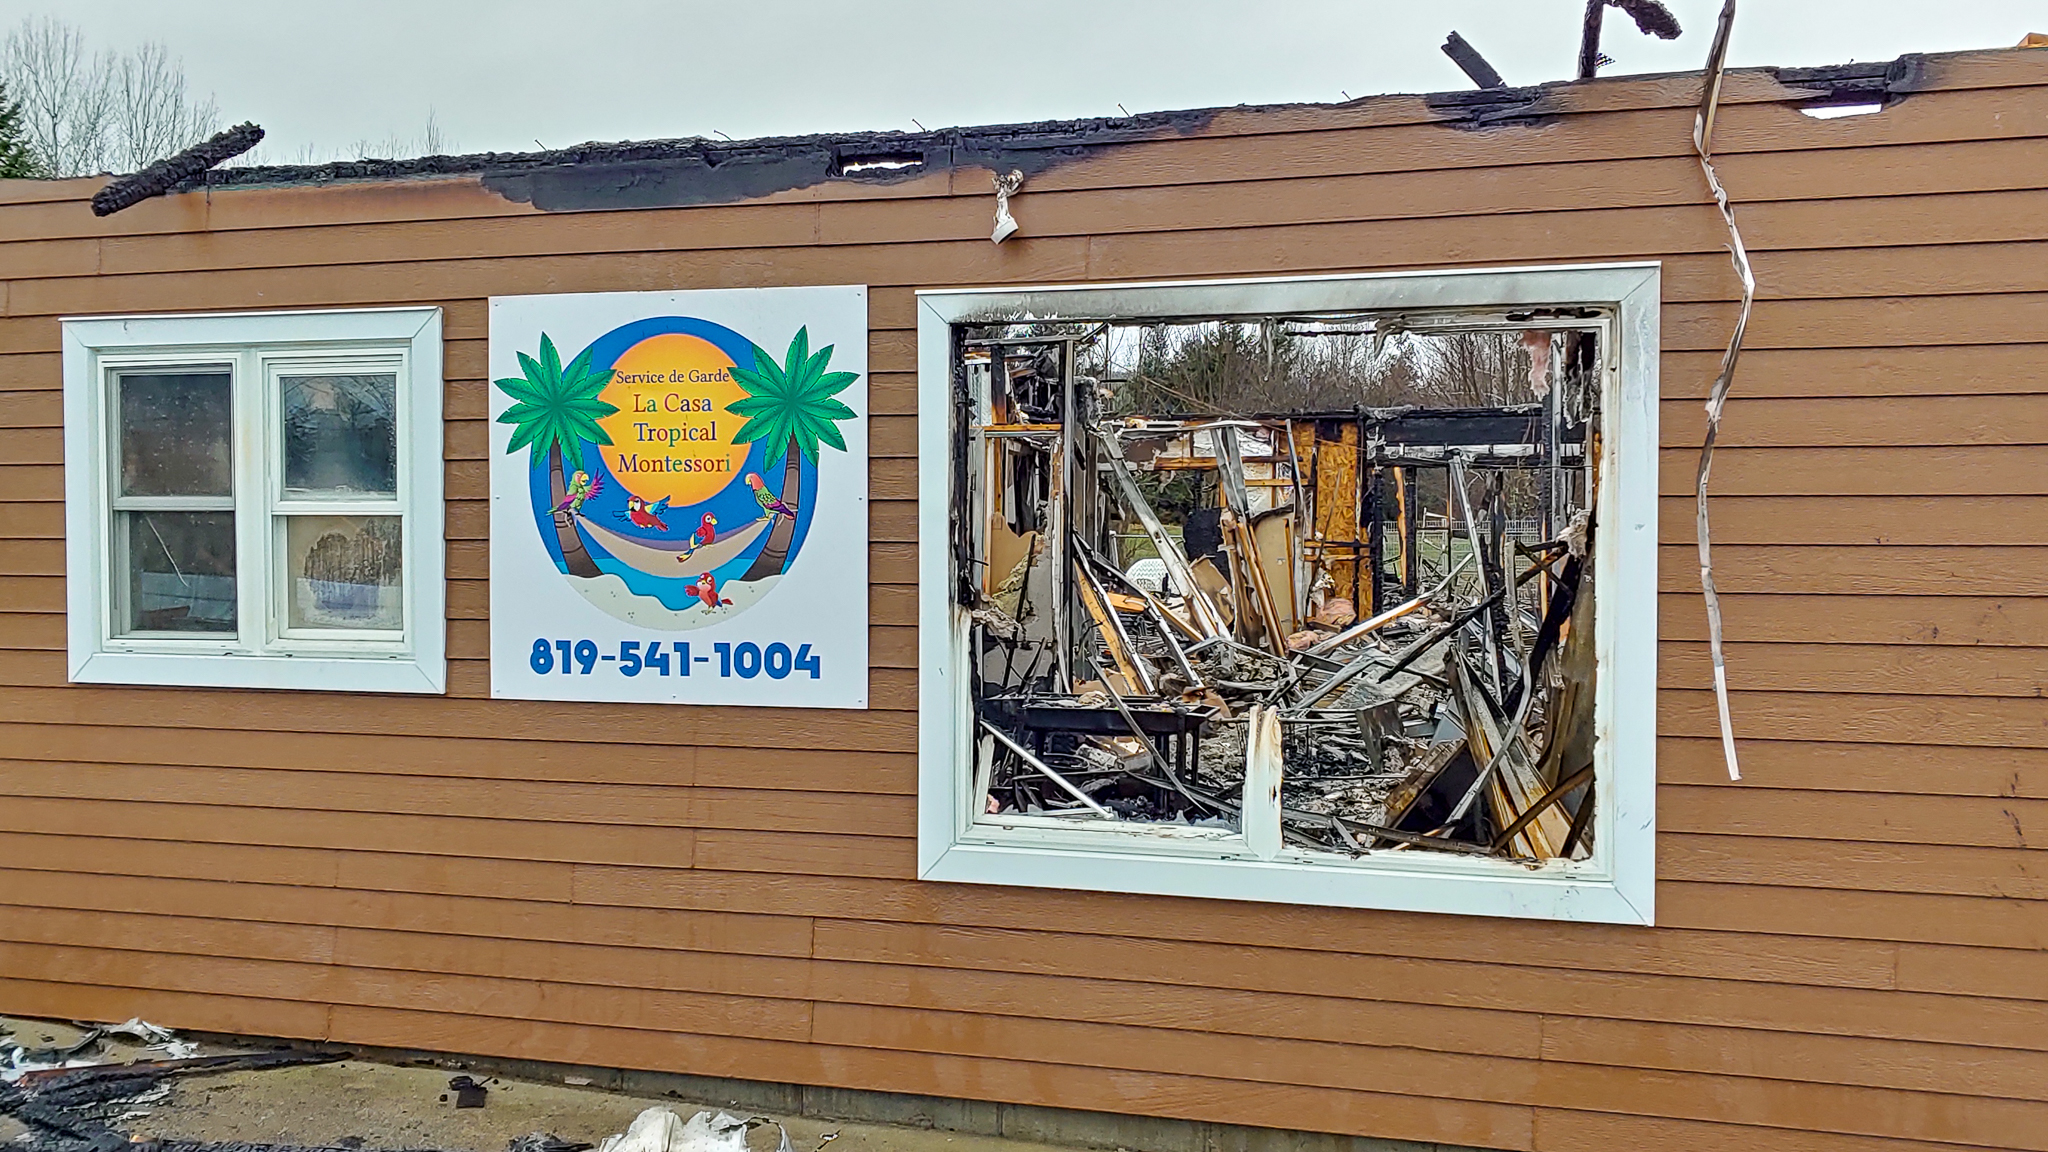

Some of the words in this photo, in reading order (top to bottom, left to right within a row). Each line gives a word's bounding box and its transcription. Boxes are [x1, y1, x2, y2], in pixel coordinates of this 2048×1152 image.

[616, 369, 665, 385] Service
[669, 369, 685, 384] de
[688, 368, 730, 384] Garde
[633, 393, 658, 413] La
[664, 393, 713, 413] Casa
[633, 421, 717, 448] Tropical
[617, 453, 731, 474] Montessori
[529, 637, 821, 680] 819-541-1004
